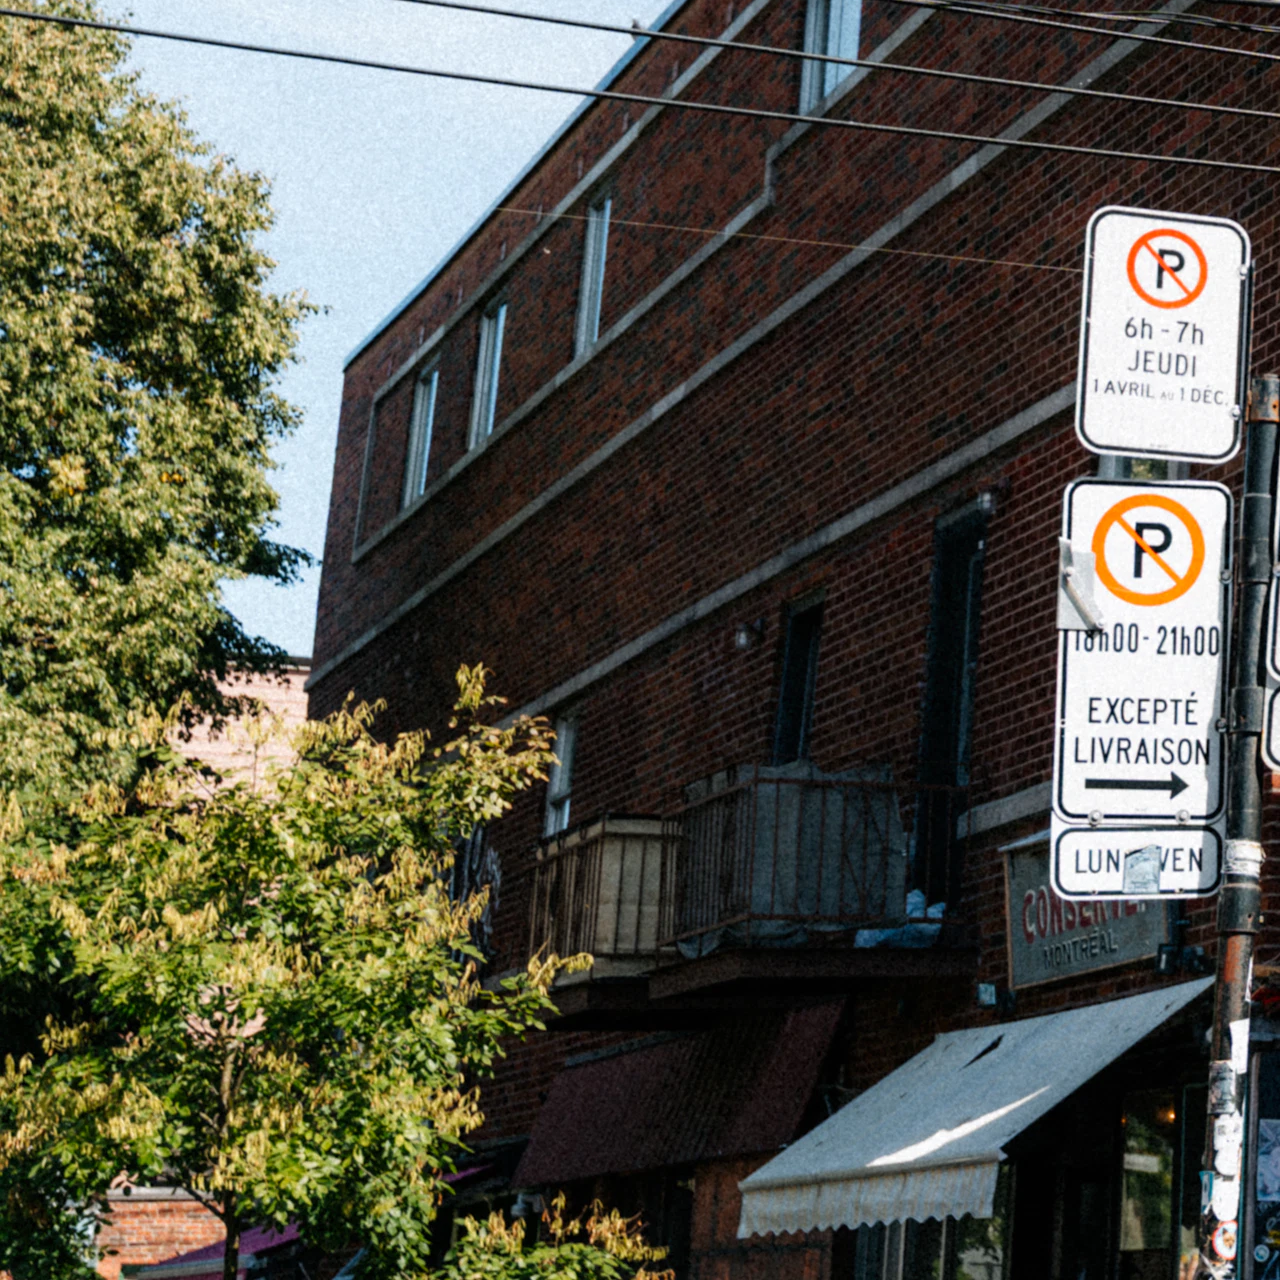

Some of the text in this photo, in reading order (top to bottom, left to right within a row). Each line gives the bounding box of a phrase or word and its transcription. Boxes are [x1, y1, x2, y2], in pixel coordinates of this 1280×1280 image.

[1124, 317, 1153, 339] 6h
[1176, 321, 1204, 345] 7h
[1128, 350, 1196, 377] JEUDI
[1094, 379, 1099, 393] 1
[1104, 380, 1155, 398] AVRIL
[1180, 387, 1185, 401] 1
[1088, 691, 1199, 726] EXCEPTÉ
[1074, 737, 1211, 766] LIVRAISON
[1075, 847, 1204, 873] LUN VEN
[1044, 927, 1118, 969] MONTRÉAL
